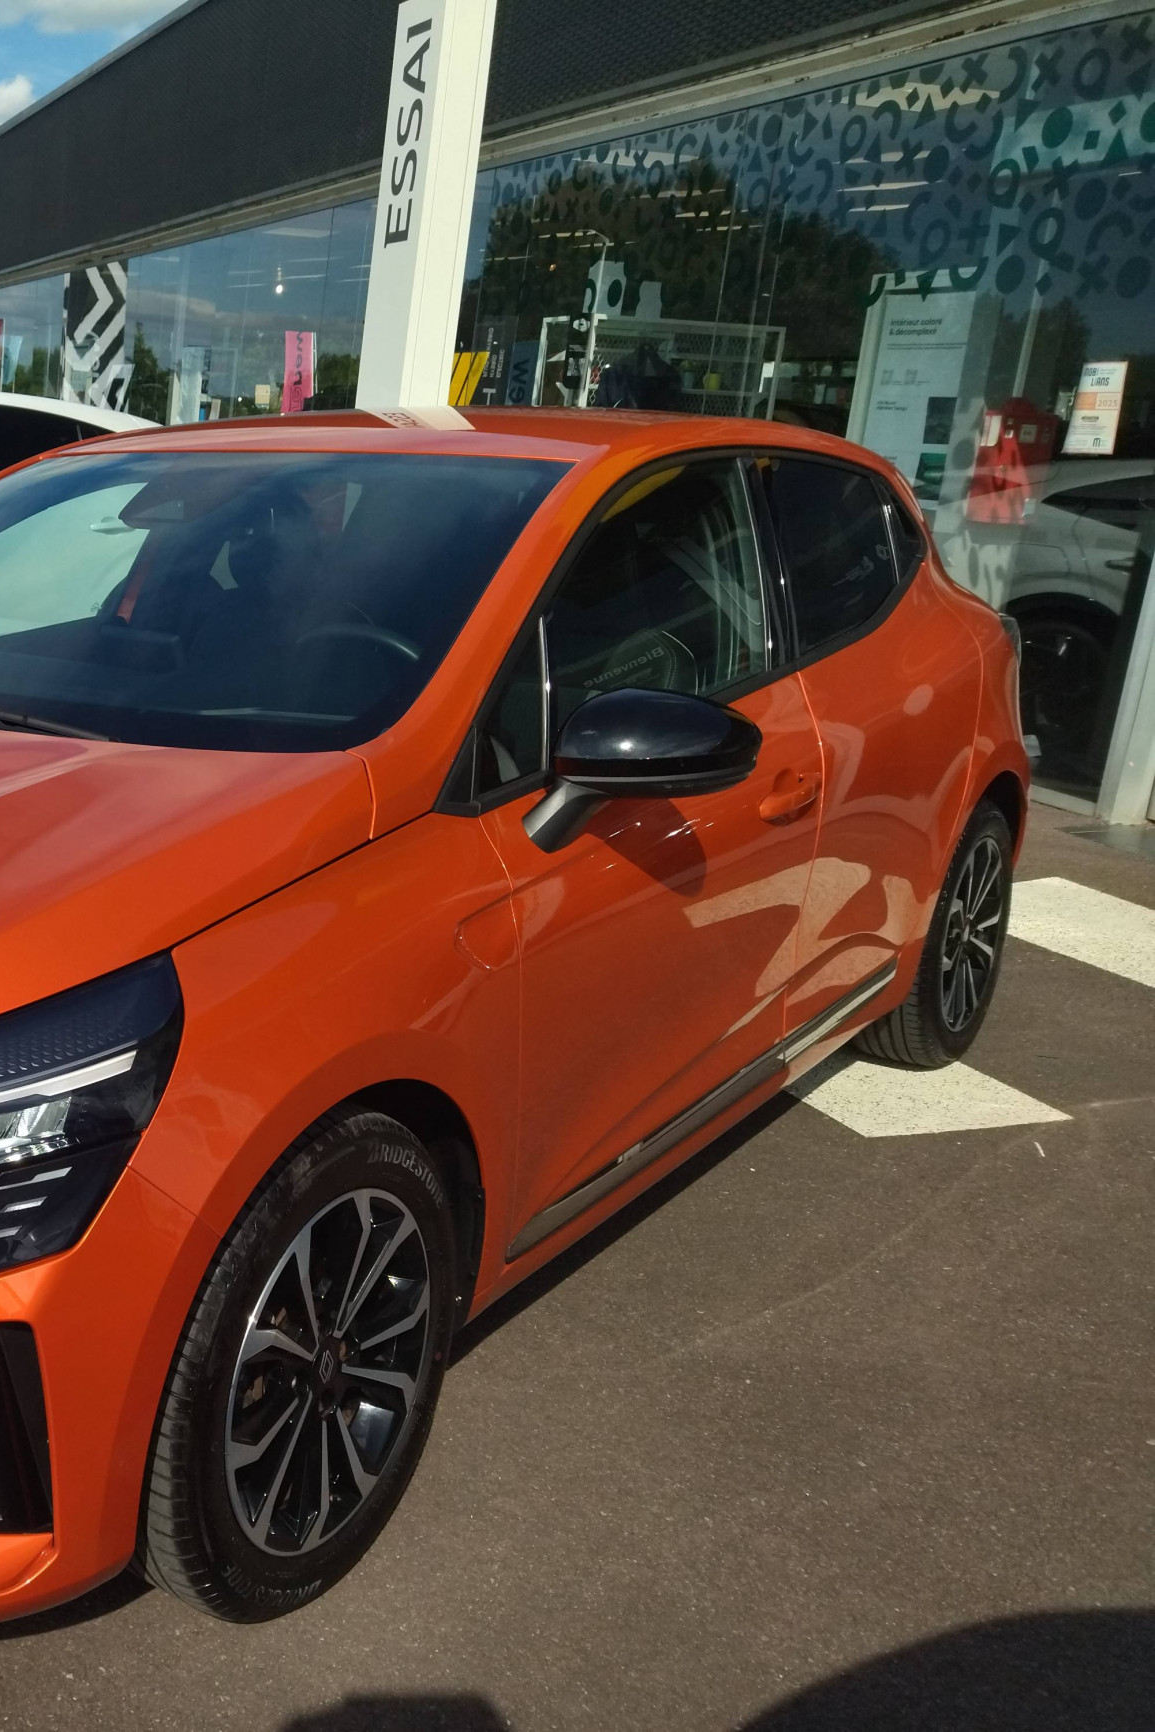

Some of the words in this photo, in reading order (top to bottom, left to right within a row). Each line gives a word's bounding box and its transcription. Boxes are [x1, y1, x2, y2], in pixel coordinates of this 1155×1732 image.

[384, 18, 433, 249] ESSAI
[890, 318, 919, 327] intérieur
[895, 327, 937, 337] décomplexé
